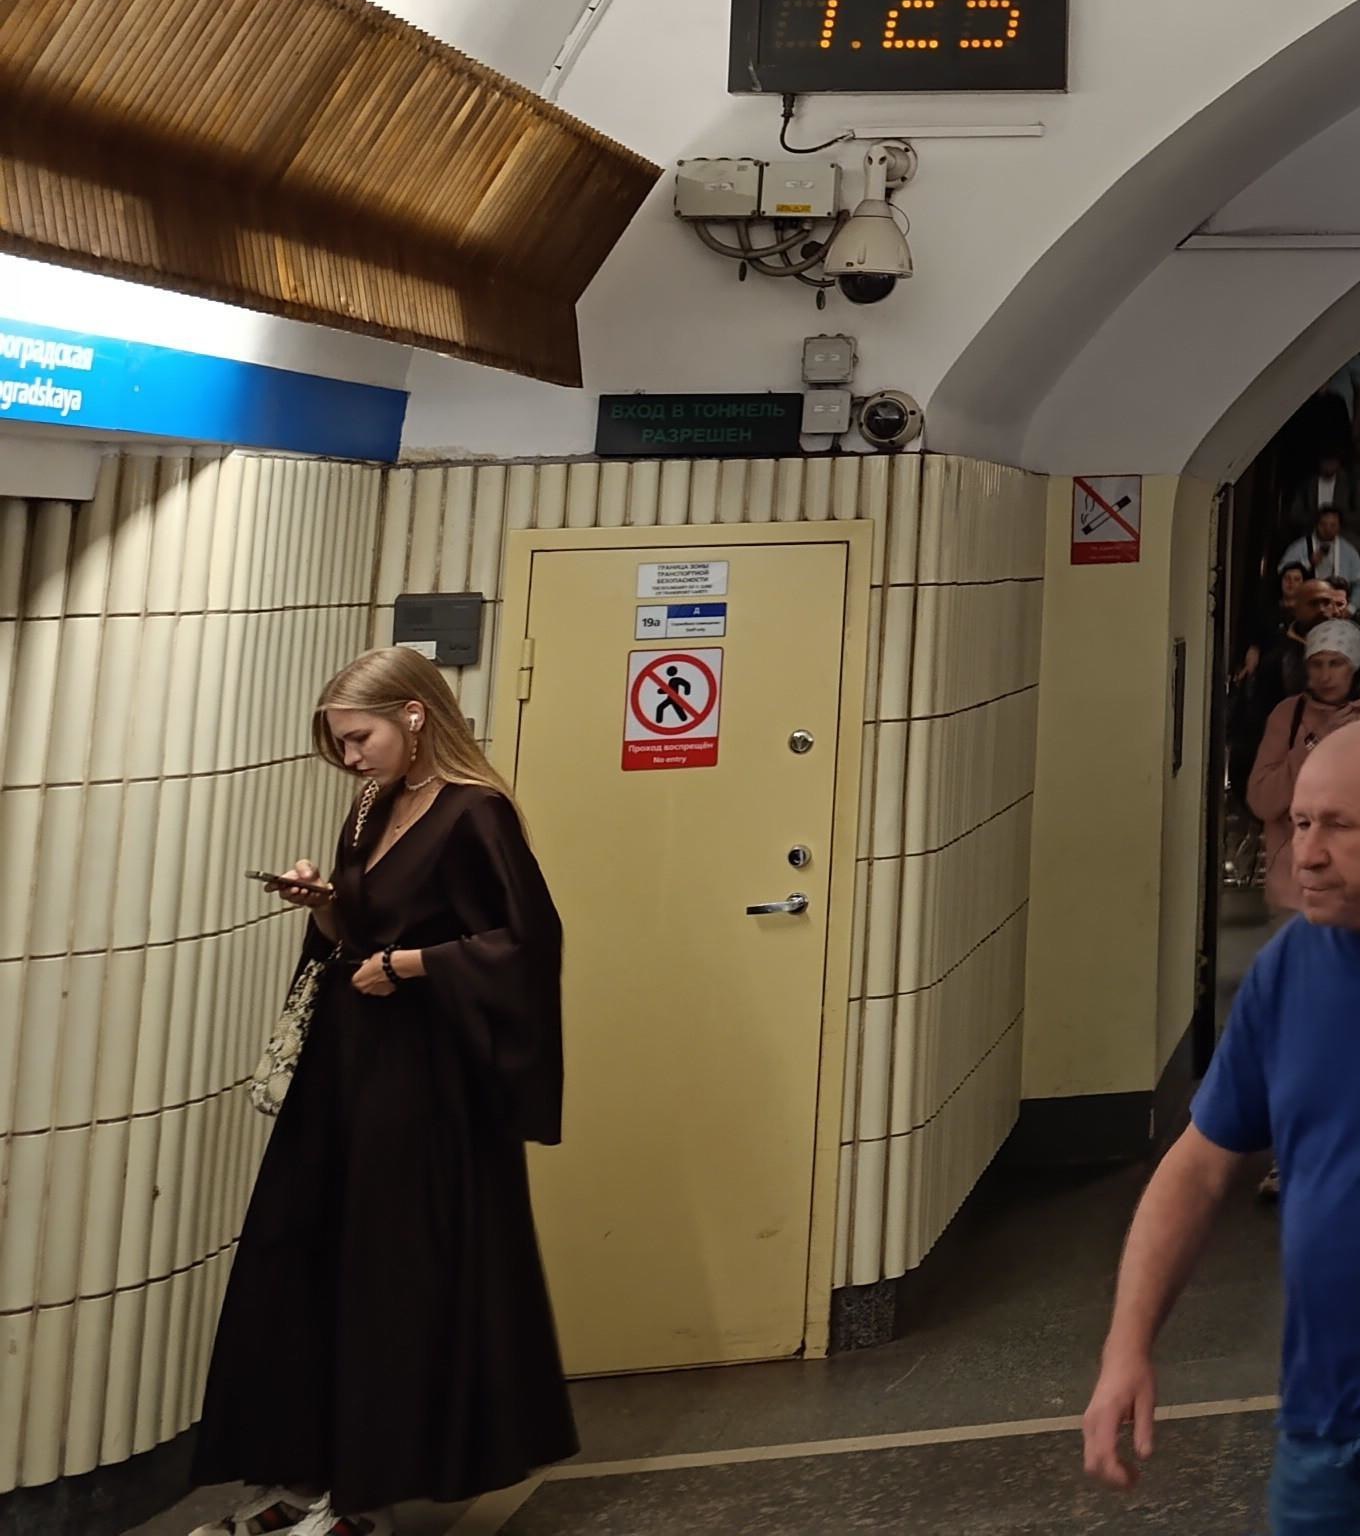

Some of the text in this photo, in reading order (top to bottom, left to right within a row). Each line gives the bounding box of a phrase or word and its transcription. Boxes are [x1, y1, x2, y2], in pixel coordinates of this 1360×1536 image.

[611, 402, 786, 420] ВХОД В ТОННЕЛЬ
[641, 428, 753, 443] РАЗРЕШЕН
[628, 744, 663, 754] Проход
